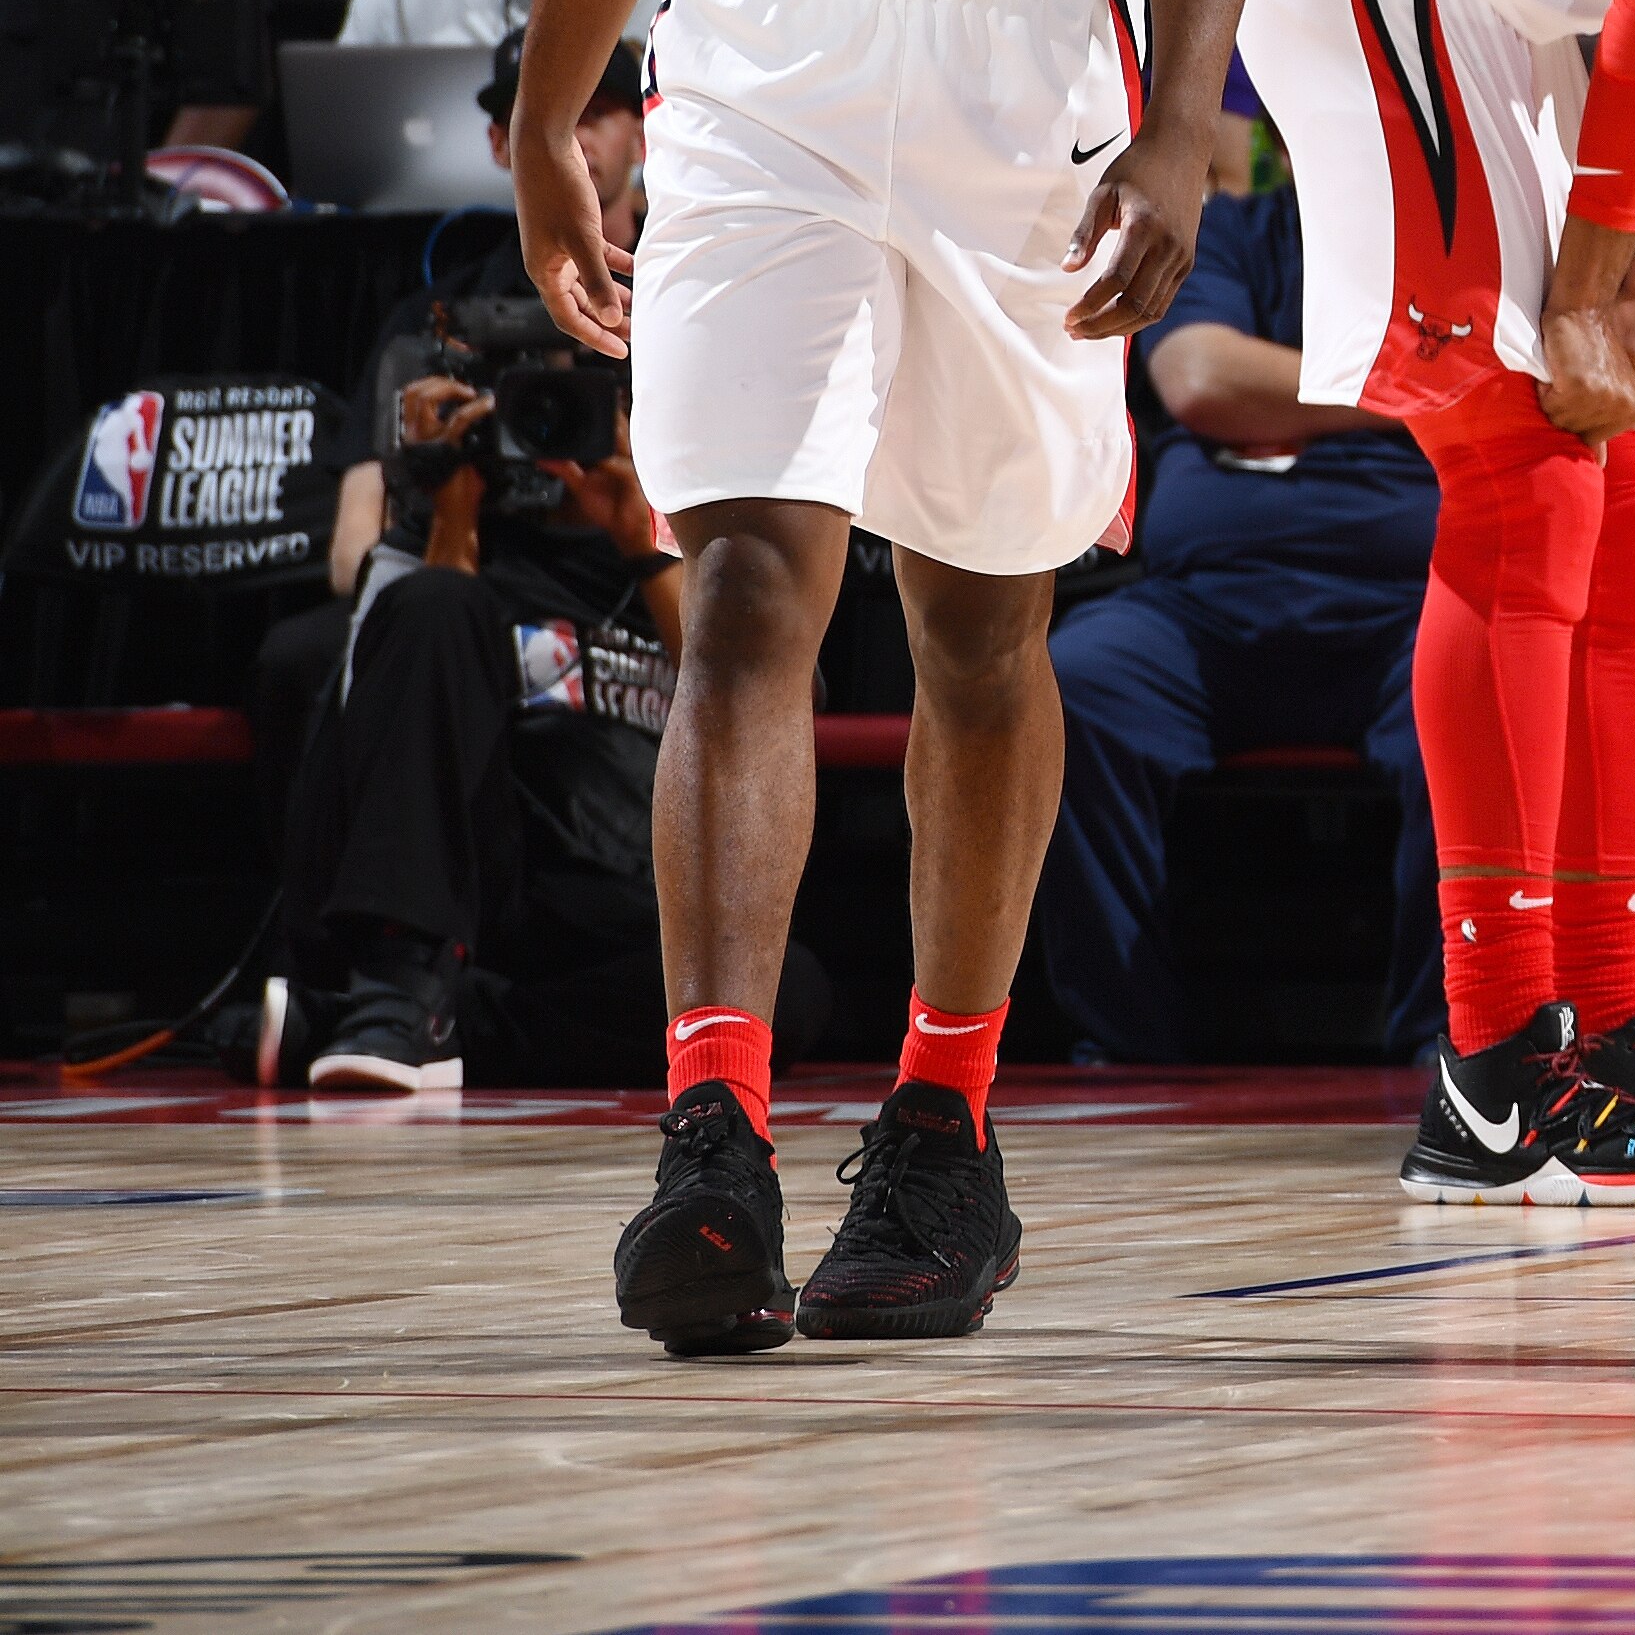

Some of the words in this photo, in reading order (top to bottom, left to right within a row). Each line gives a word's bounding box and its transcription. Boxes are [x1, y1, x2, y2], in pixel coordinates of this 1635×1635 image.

[168, 409, 315, 471] SUMMER
[159, 462, 288, 529] LEAGUE
[65, 538, 128, 571] VIP
[134, 531, 311, 576] RESERVED
